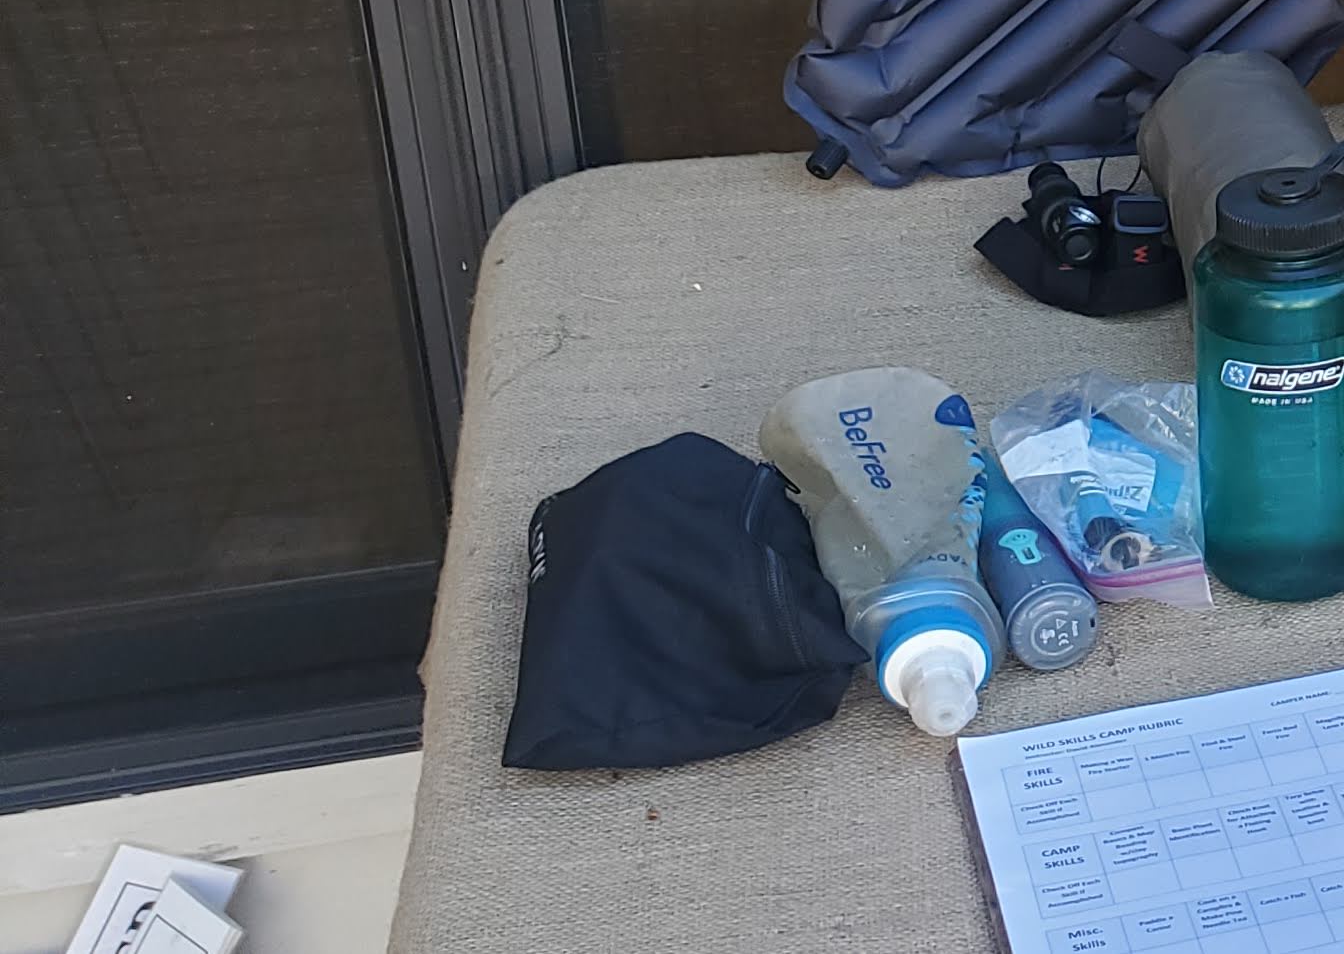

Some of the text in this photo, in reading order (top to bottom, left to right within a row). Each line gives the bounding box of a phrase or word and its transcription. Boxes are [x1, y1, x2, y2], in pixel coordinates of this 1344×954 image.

[1253, 366, 1340, 391] nalgene
[1251, 396, 1314, 406] MADE IN USA
[839, 407, 892, 489] BeFree
[1270, 696, 1304, 707] CAMPER
[1022, 741, 1056, 752] WILD
[1058, 734, 1097, 746] SKILLS
[1099, 726, 1135, 739] CAMP
[1138, 718, 1183, 731] RUBRIC
[1026, 767, 1053, 777] FIRE
[1023, 777, 1063, 790] SKILLS
[1041, 845, 1080, 857] CAMP
[1044, 856, 1085, 869] SKILLS
[1067, 928, 1103, 939] Misc.
[1072, 939, 1106, 952] Skills
